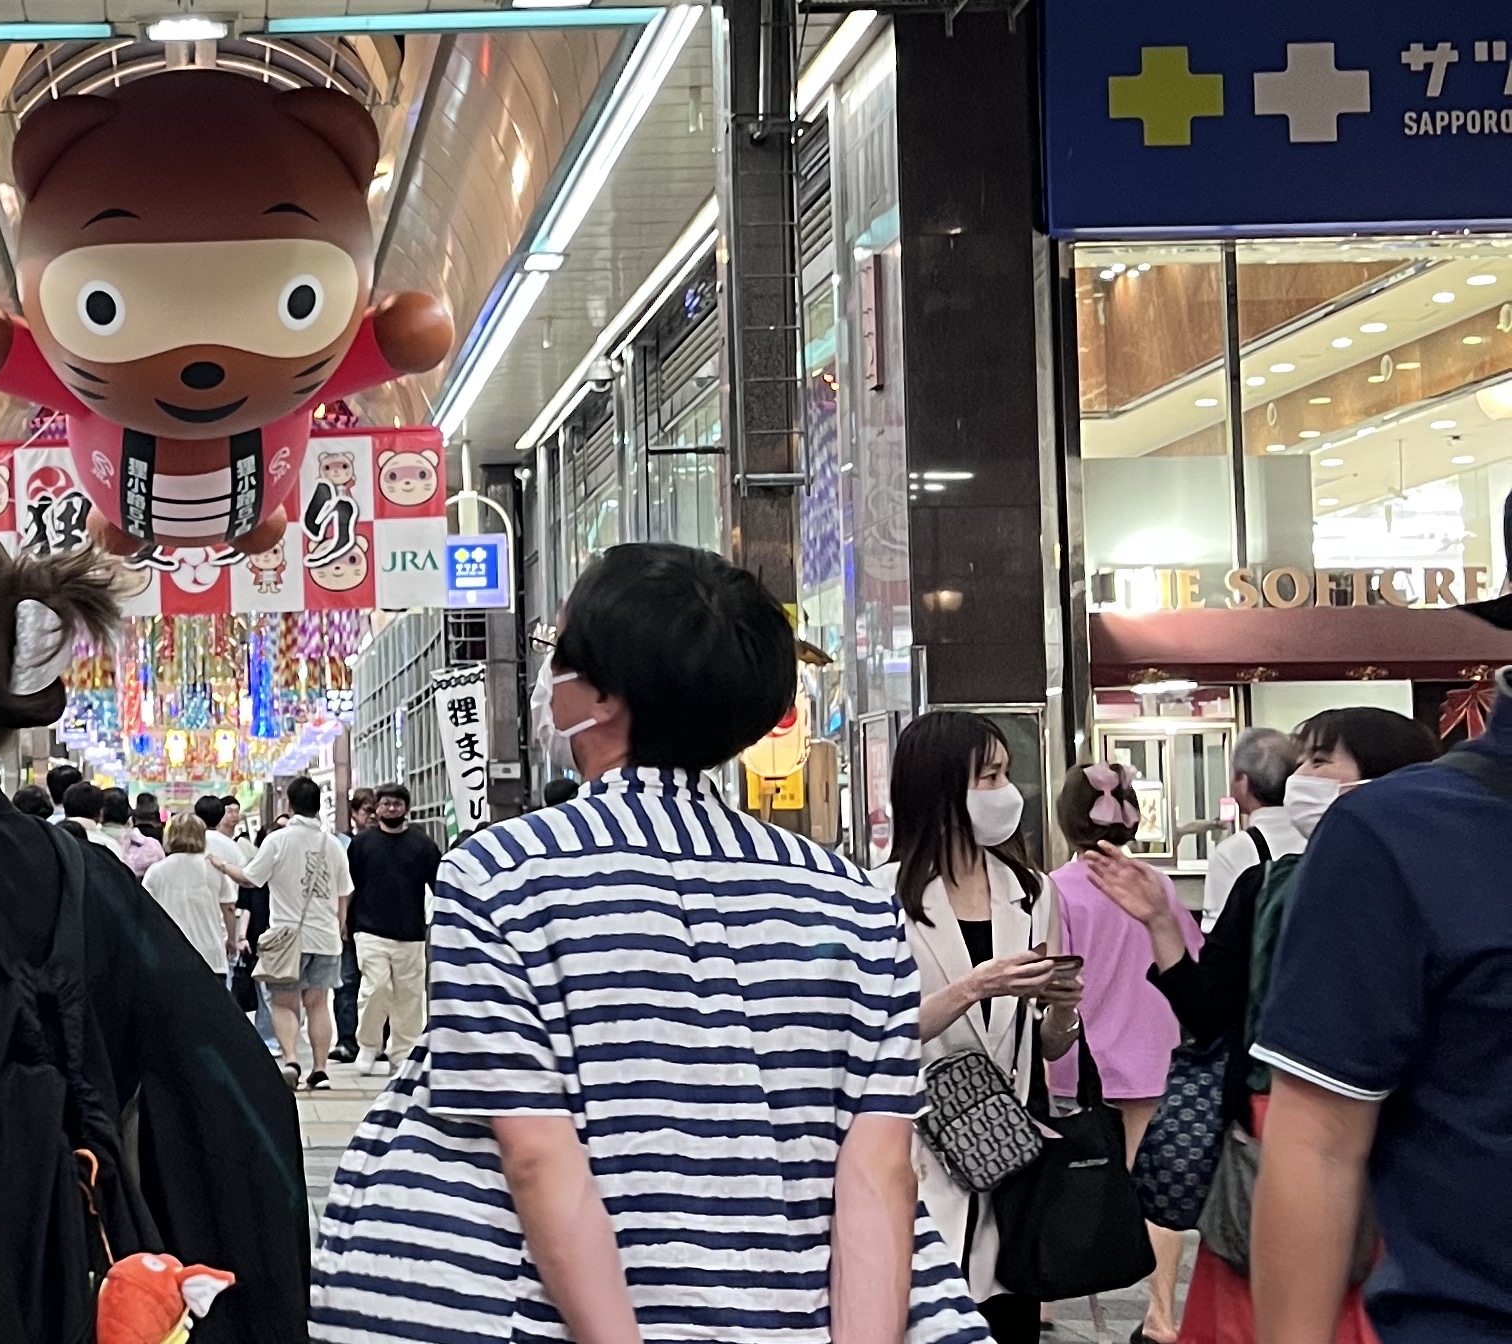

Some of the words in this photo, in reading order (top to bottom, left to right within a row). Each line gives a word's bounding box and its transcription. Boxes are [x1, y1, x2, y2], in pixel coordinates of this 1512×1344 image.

[1403, 109, 1512, 136] SAPPORO
[381, 549, 440, 573] JRA
[447, 696, 485, 820] 狸まつり
